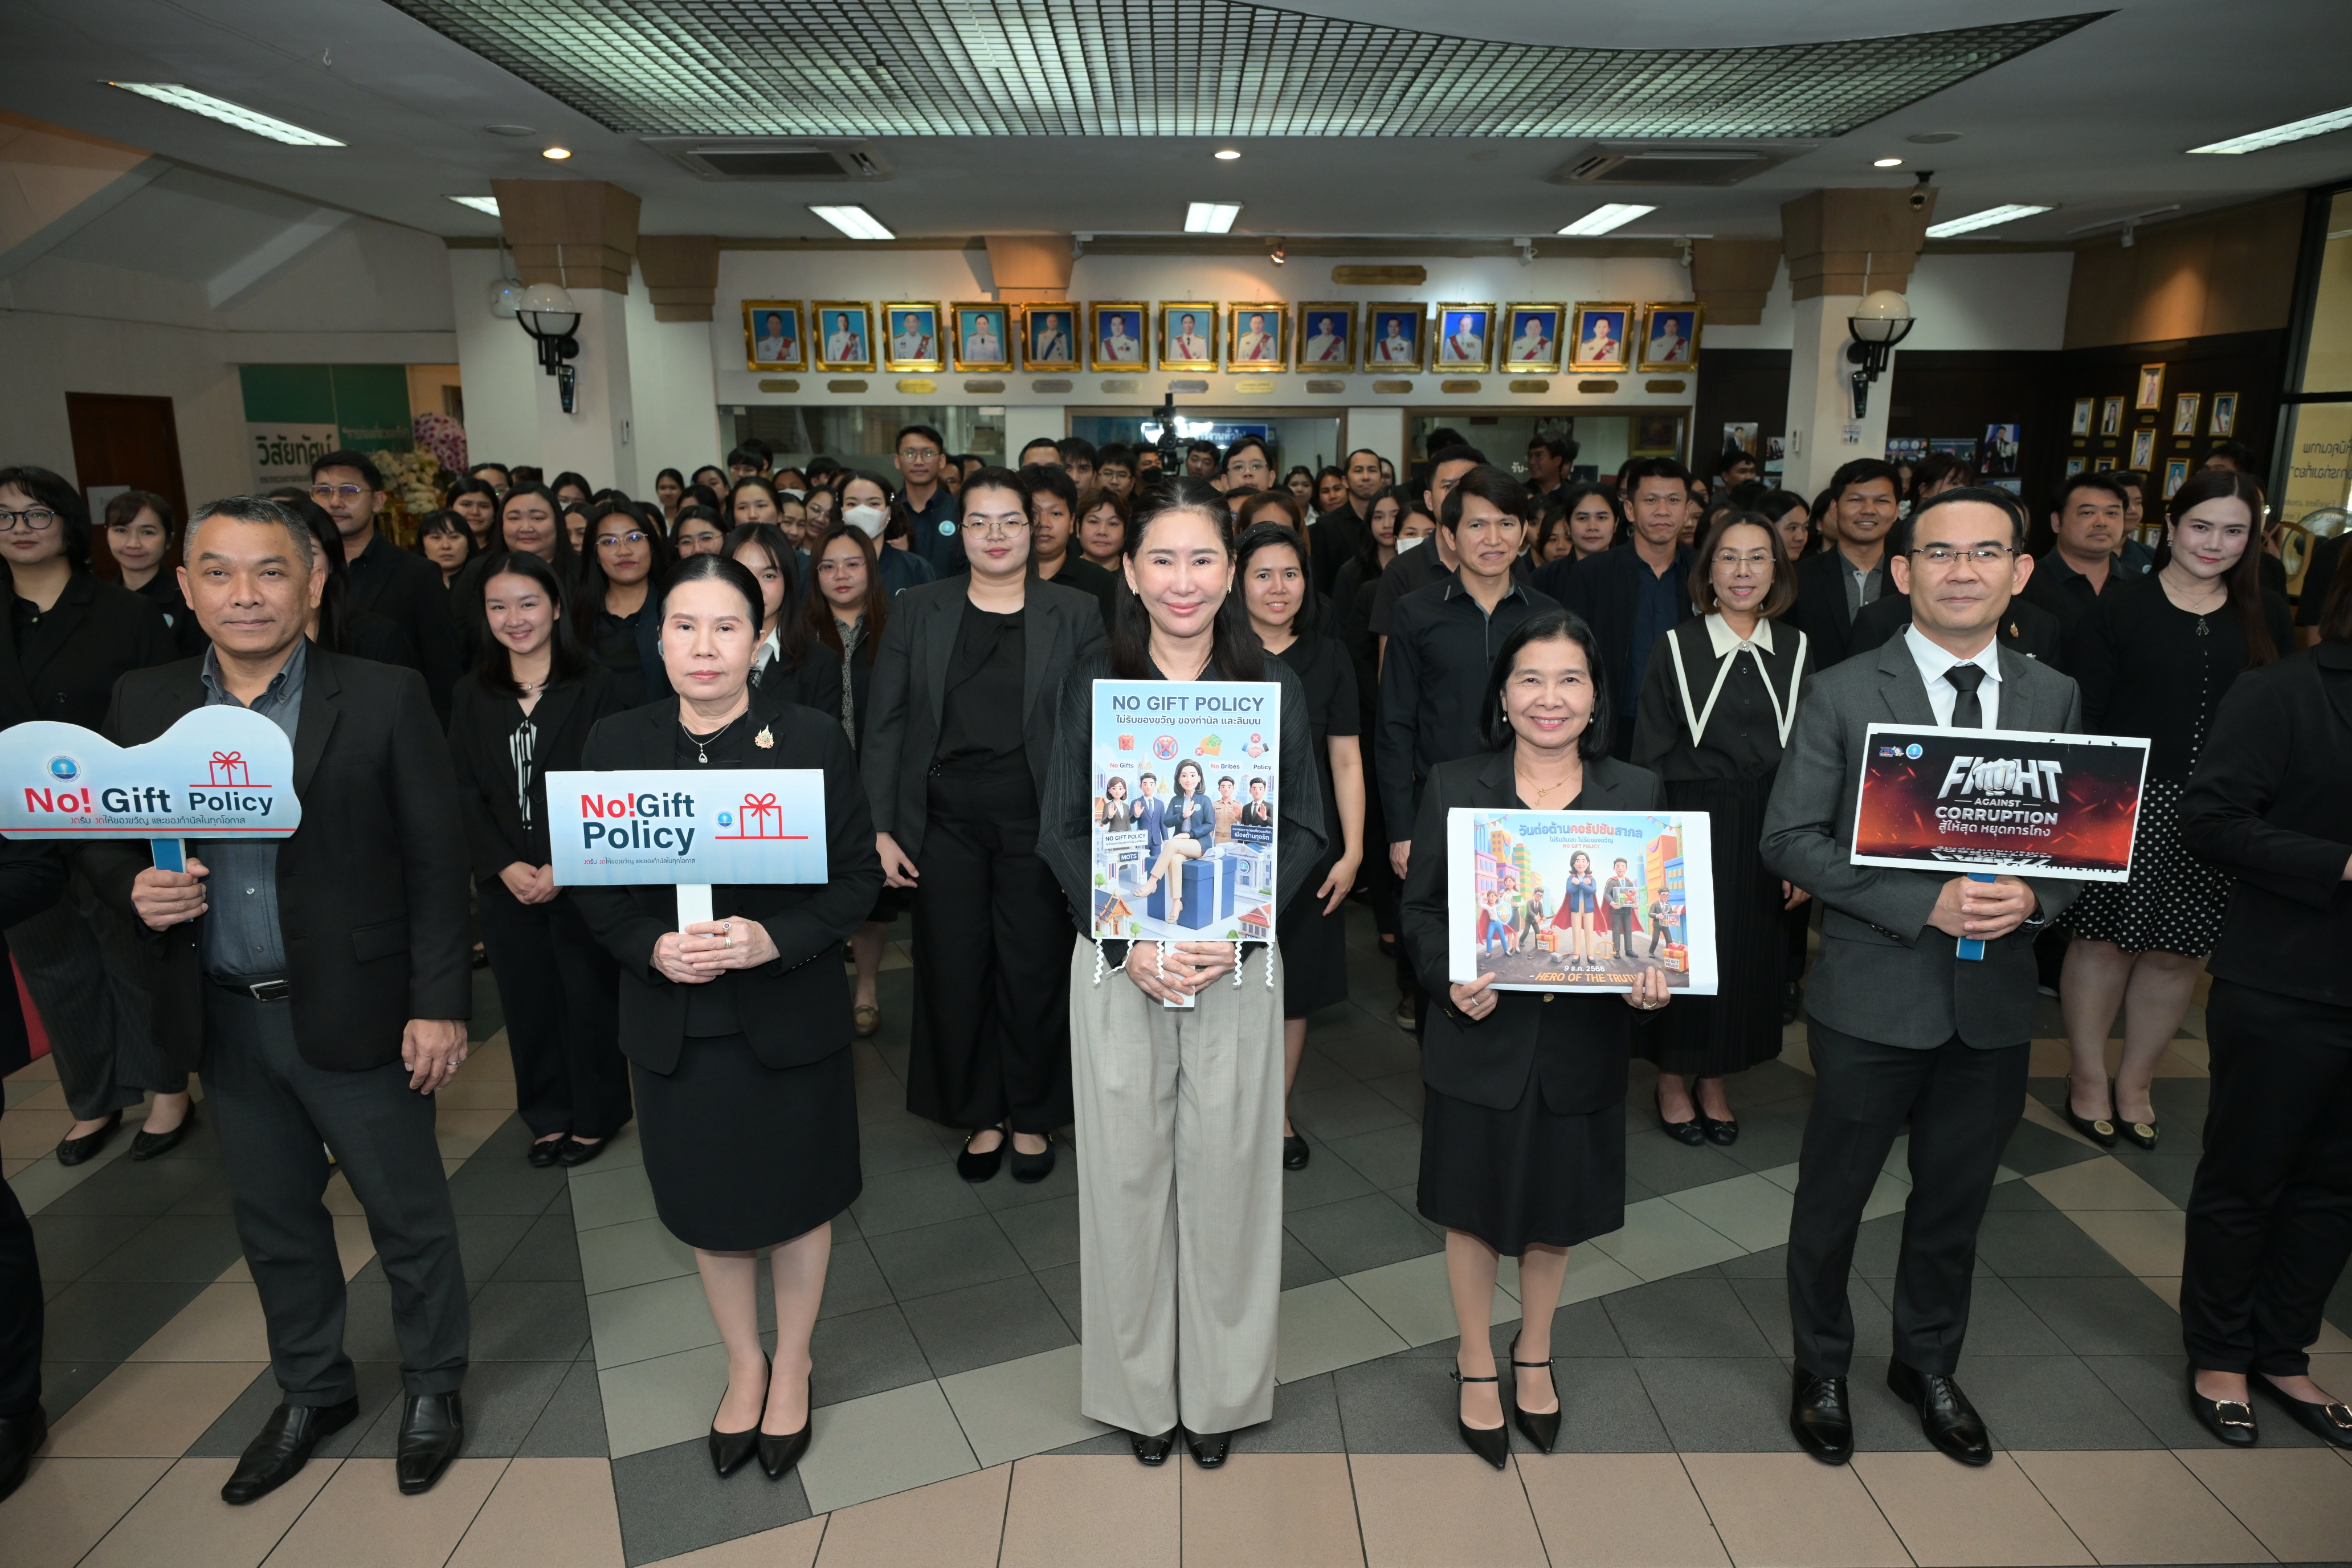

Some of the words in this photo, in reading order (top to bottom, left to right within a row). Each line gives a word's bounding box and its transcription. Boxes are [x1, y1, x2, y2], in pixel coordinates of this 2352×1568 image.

[1113, 696, 1141, 710] NO
[1146, 696, 1189, 711] GIFT
[1195, 697, 1264, 712] POLICY
[1116, 714, 1175, 725] ไม่รับของขวัญ
[1178, 716, 1218, 725] ของกำนัล
[1221, 716, 1261, 725] และสินบน
[1937, 756, 2063, 804] FIHT
[24, 787, 92, 813] No!
[101, 787, 172, 813] Gift
[190, 791, 273, 816] Policy
[1974, 798, 2021, 807] AGAINST
[71, 815, 91, 824] งดรับ
[152, 815, 245, 826] และของกำนัลในทุกโอกาส
[1935, 806, 2058, 825] CORRUPTION
[1938, 819, 1978, 835] สู้ให้สุด
[1981, 824, 2051, 836] หยุดการโกง
[583, 820, 696, 856] Policy
[1534, 972, 1565, 982] HERO
[1567, 973, 1582, 982] OF
[1585, 973, 1606, 983] THE
